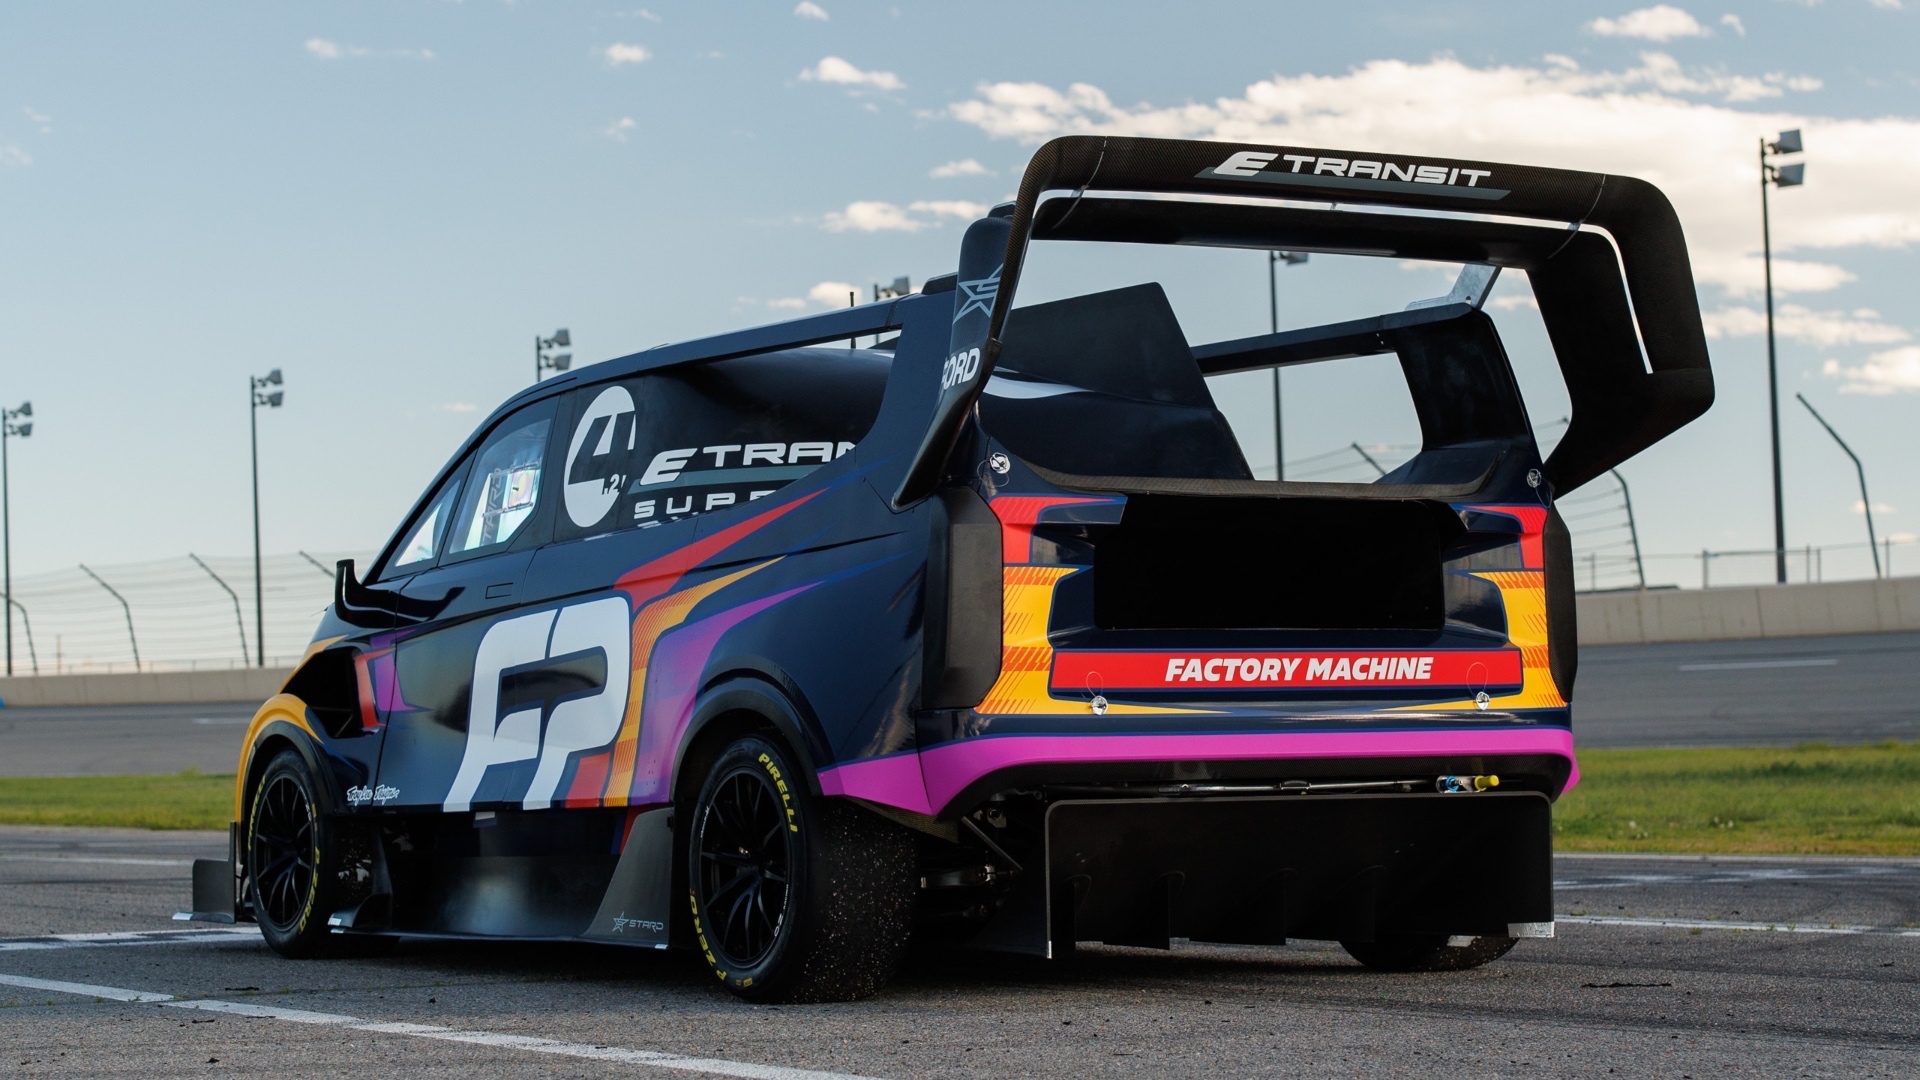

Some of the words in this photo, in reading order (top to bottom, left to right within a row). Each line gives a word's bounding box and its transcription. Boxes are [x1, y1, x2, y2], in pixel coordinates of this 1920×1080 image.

[443, 596, 630, 812] FP
[1164, 658, 1301, 682] FACTORY
[1305, 657, 1434, 681] MACHINE
[758, 753, 798, 833] PIRELLI
[628, 919, 664, 933] STARD
[690, 895, 716, 966] ZERO
